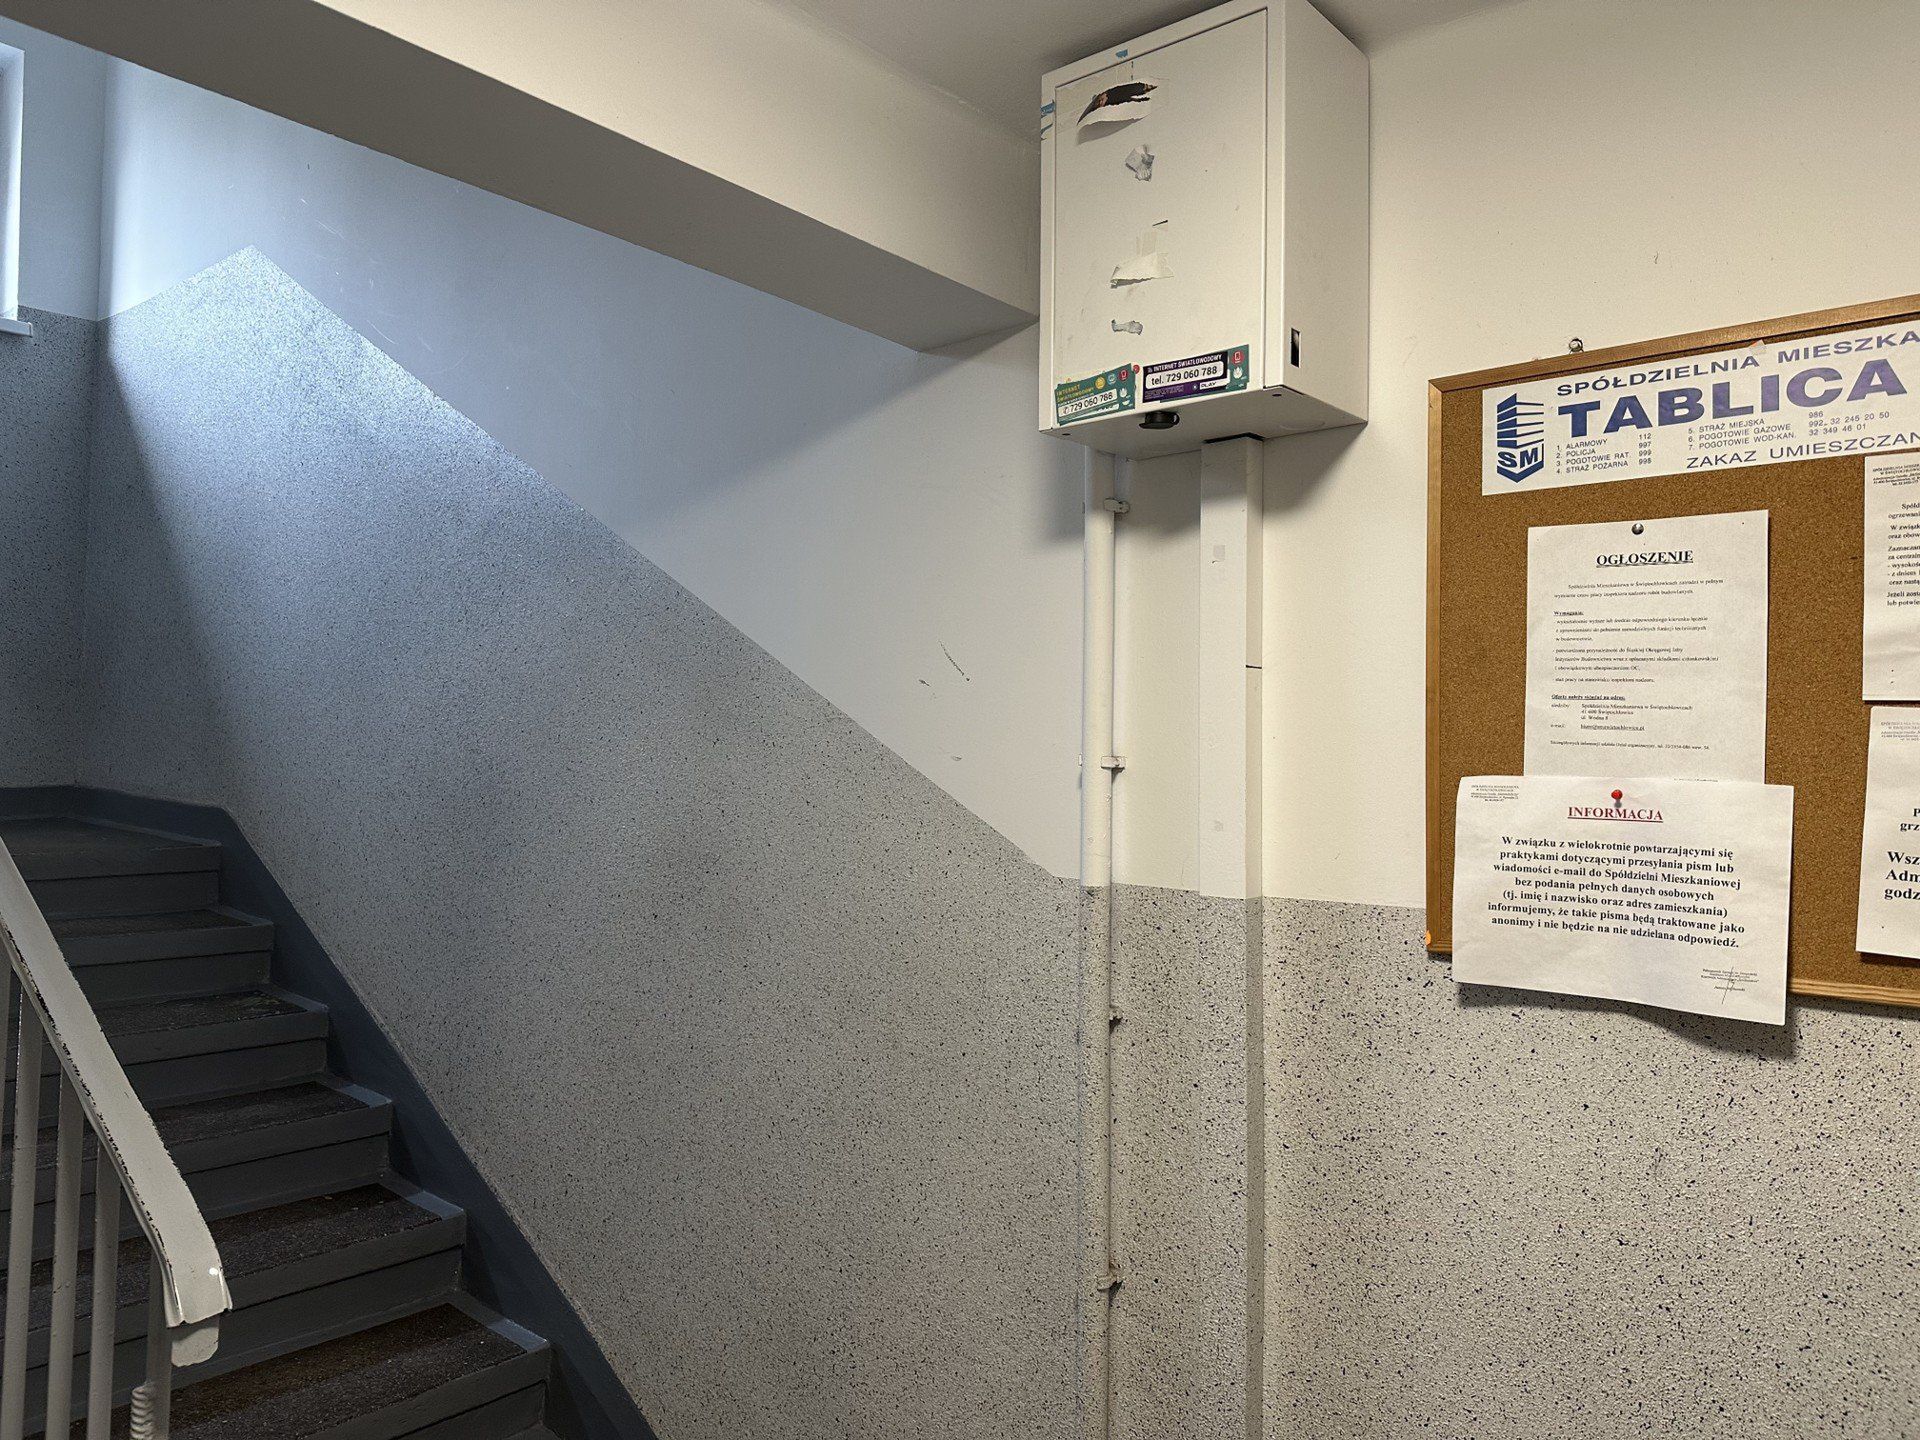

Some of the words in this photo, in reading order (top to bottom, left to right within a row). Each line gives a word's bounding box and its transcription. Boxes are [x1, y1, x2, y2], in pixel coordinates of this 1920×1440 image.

[1153, 362, 1177, 373] INTERNET
[1557, 355, 1760, 396] SPÓŁDZIELNIA
[1778, 330, 1920, 365] MIESZKA
[1151, 375, 1164, 386] tel.
[1166, 373, 1181, 383] 729
[1184, 369, 1199, 379] 060
[1202, 366, 1217, 376] 788
[1070, 402, 1083, 413] 729
[1084, 397, 1098, 408] 060
[1558, 359, 1908, 439] TABLICA
[1699, 422, 1726, 433] STRAŻ
[1729, 418, 1765, 429] MIEJSKA
[1808, 411, 1824, 419] 986
[1699, 428, 1750, 441] POGOTOWIE
[1753, 423, 1791, 436] GAZOWE
[1831, 417, 1840, 426] 32
[1844, 414, 1860, 424] 245
[1864, 413, 1875, 421] 20
[1879, 410, 1890, 419] 50
[1566, 438, 1608, 449] ALARMOWY
[1638, 432, 1652, 440] 112
[1699, 437, 1750, 450] POGOTOWIE
[1753, 432, 1797, 443] WOD-KAN.
[1808, 428, 1819, 437] 32
[1823, 426, 1838, 435] 349
[1842, 424, 1853, 433] 46
[1856, 422, 1866, 431] 01
[1497, 447, 1539, 469] SM
[1566, 449, 1596, 457] POLICJA
[1638, 441, 1652, 449] 997
[1566, 454, 1610, 466] POGOTOWIE
[1566, 464, 1590, 474] STRAŻ
[1593, 460, 1629, 471] POŻARNA
[1686, 451, 1757, 469] ZAKAZ
[1596, 550, 1694, 566] OGŁOSZENIE
[1567, 806, 1663, 821] INFORMACJA
[1900, 823, 1920, 832] grz
[1502, 836, 1513, 845] W
[1515, 838, 1556, 848] związku
[1568, 840, 1631, 852] wielokrotnie
[1633, 845, 1715, 858] powtarzającymi
[1718, 849, 1734, 861] się
[1887, 851, 1920, 865] Wsz
[1500, 850, 1559, 861] praktykami
[1561, 853, 1625, 866] dotyczącymi
[1628, 858, 1683, 869] przesyłania
[1686, 861, 1712, 872] pism
[1715, 862, 1734, 873] lub
[1493, 863, 1551, 874] wiadomości
[1554, 867, 1586, 876] e-mail
[1588, 868, 1602, 877] do
[1605, 869, 1658, 882] Spółdzielni
[1660, 873, 1741, 890] Mieszkaniowej
[1515, 877, 1532, 886] bez
[1535, 879, 1575, 889] podania
[1578, 881, 1618, 893] pełnych
[1621, 884, 1656, 897] danych
[1658, 888, 1715, 901] osobowych
[1884, 888, 1920, 901] godz
[1503, 889, 1518, 900] (tj.
[1520, 890, 1542, 902] imię
[1544, 892, 1548, 901] i
[1551, 894, 1598, 905] nazwisko
[1601, 898, 1624, 907] oraz
[1626, 899, 1652, 909] adres
[1654, 902, 1728, 918] zamieszkania)
[1487, 902, 1555, 917] informujemy,
[1558, 907, 1569, 916] że
[1571, 908, 1597, 918] takie
[1600, 910, 1629, 922] pisma
[1632, 912, 1655, 926] będą
[1657, 917, 1716, 930] traktowane
[1719, 922, 1745, 933] jako
[1491, 917, 1535, 928] anonimy
[1537, 919, 1541, 928] i
[1544, 920, 1559, 929] nie
[1562, 921, 1594, 933] będzie
[1597, 925, 1610, 933] na
[1613, 925, 1628, 935] nie
[1630, 927, 1675, 940] udzielana
[1677, 933, 1739, 948] odpowiedź.
